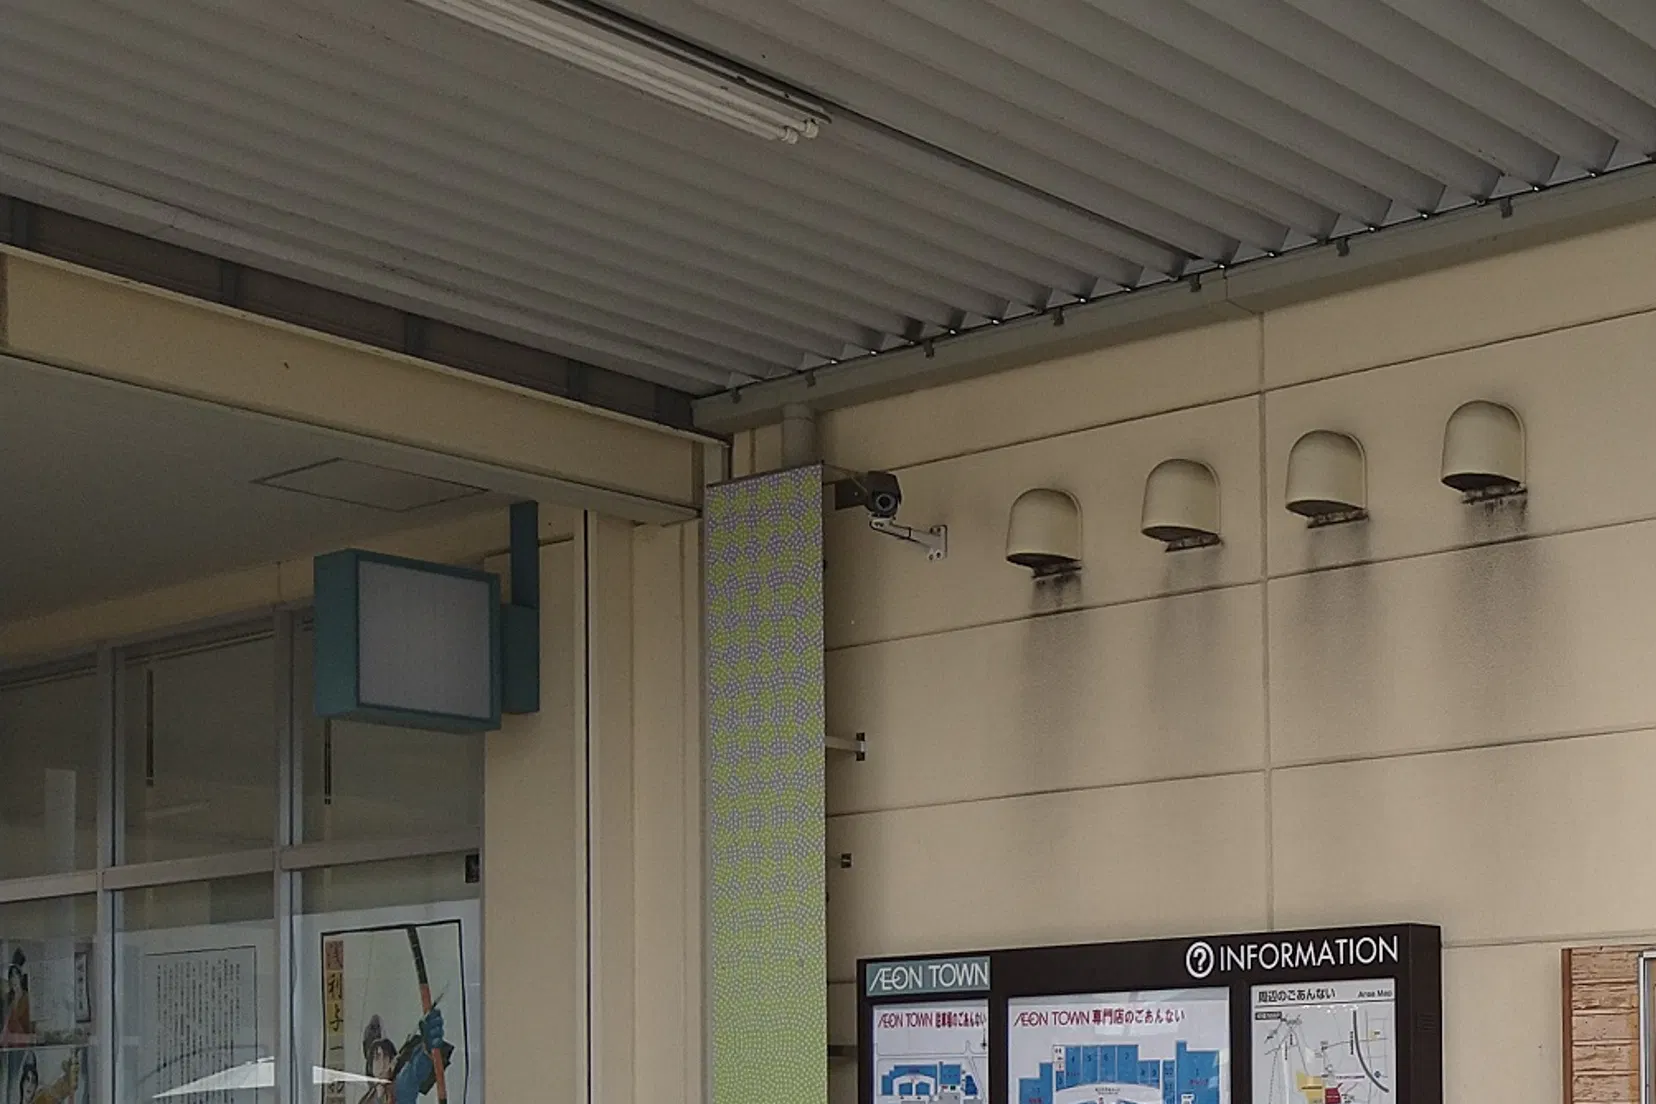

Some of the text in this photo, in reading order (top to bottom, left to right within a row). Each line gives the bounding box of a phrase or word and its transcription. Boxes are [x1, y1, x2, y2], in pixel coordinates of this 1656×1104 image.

[1219, 935, 1399, 972] INFORMATION
[928, 961, 988, 988] TOWN
[1258, 988, 1336, 1003] 周辺のごあんない
[1357, 990, 1376, 998] Area
[905, 1011, 933, 1027] TOWN
[1051, 1010, 1089, 1026] TOWN
[1092, 1008, 1186, 1025] 専門店のごあんない
